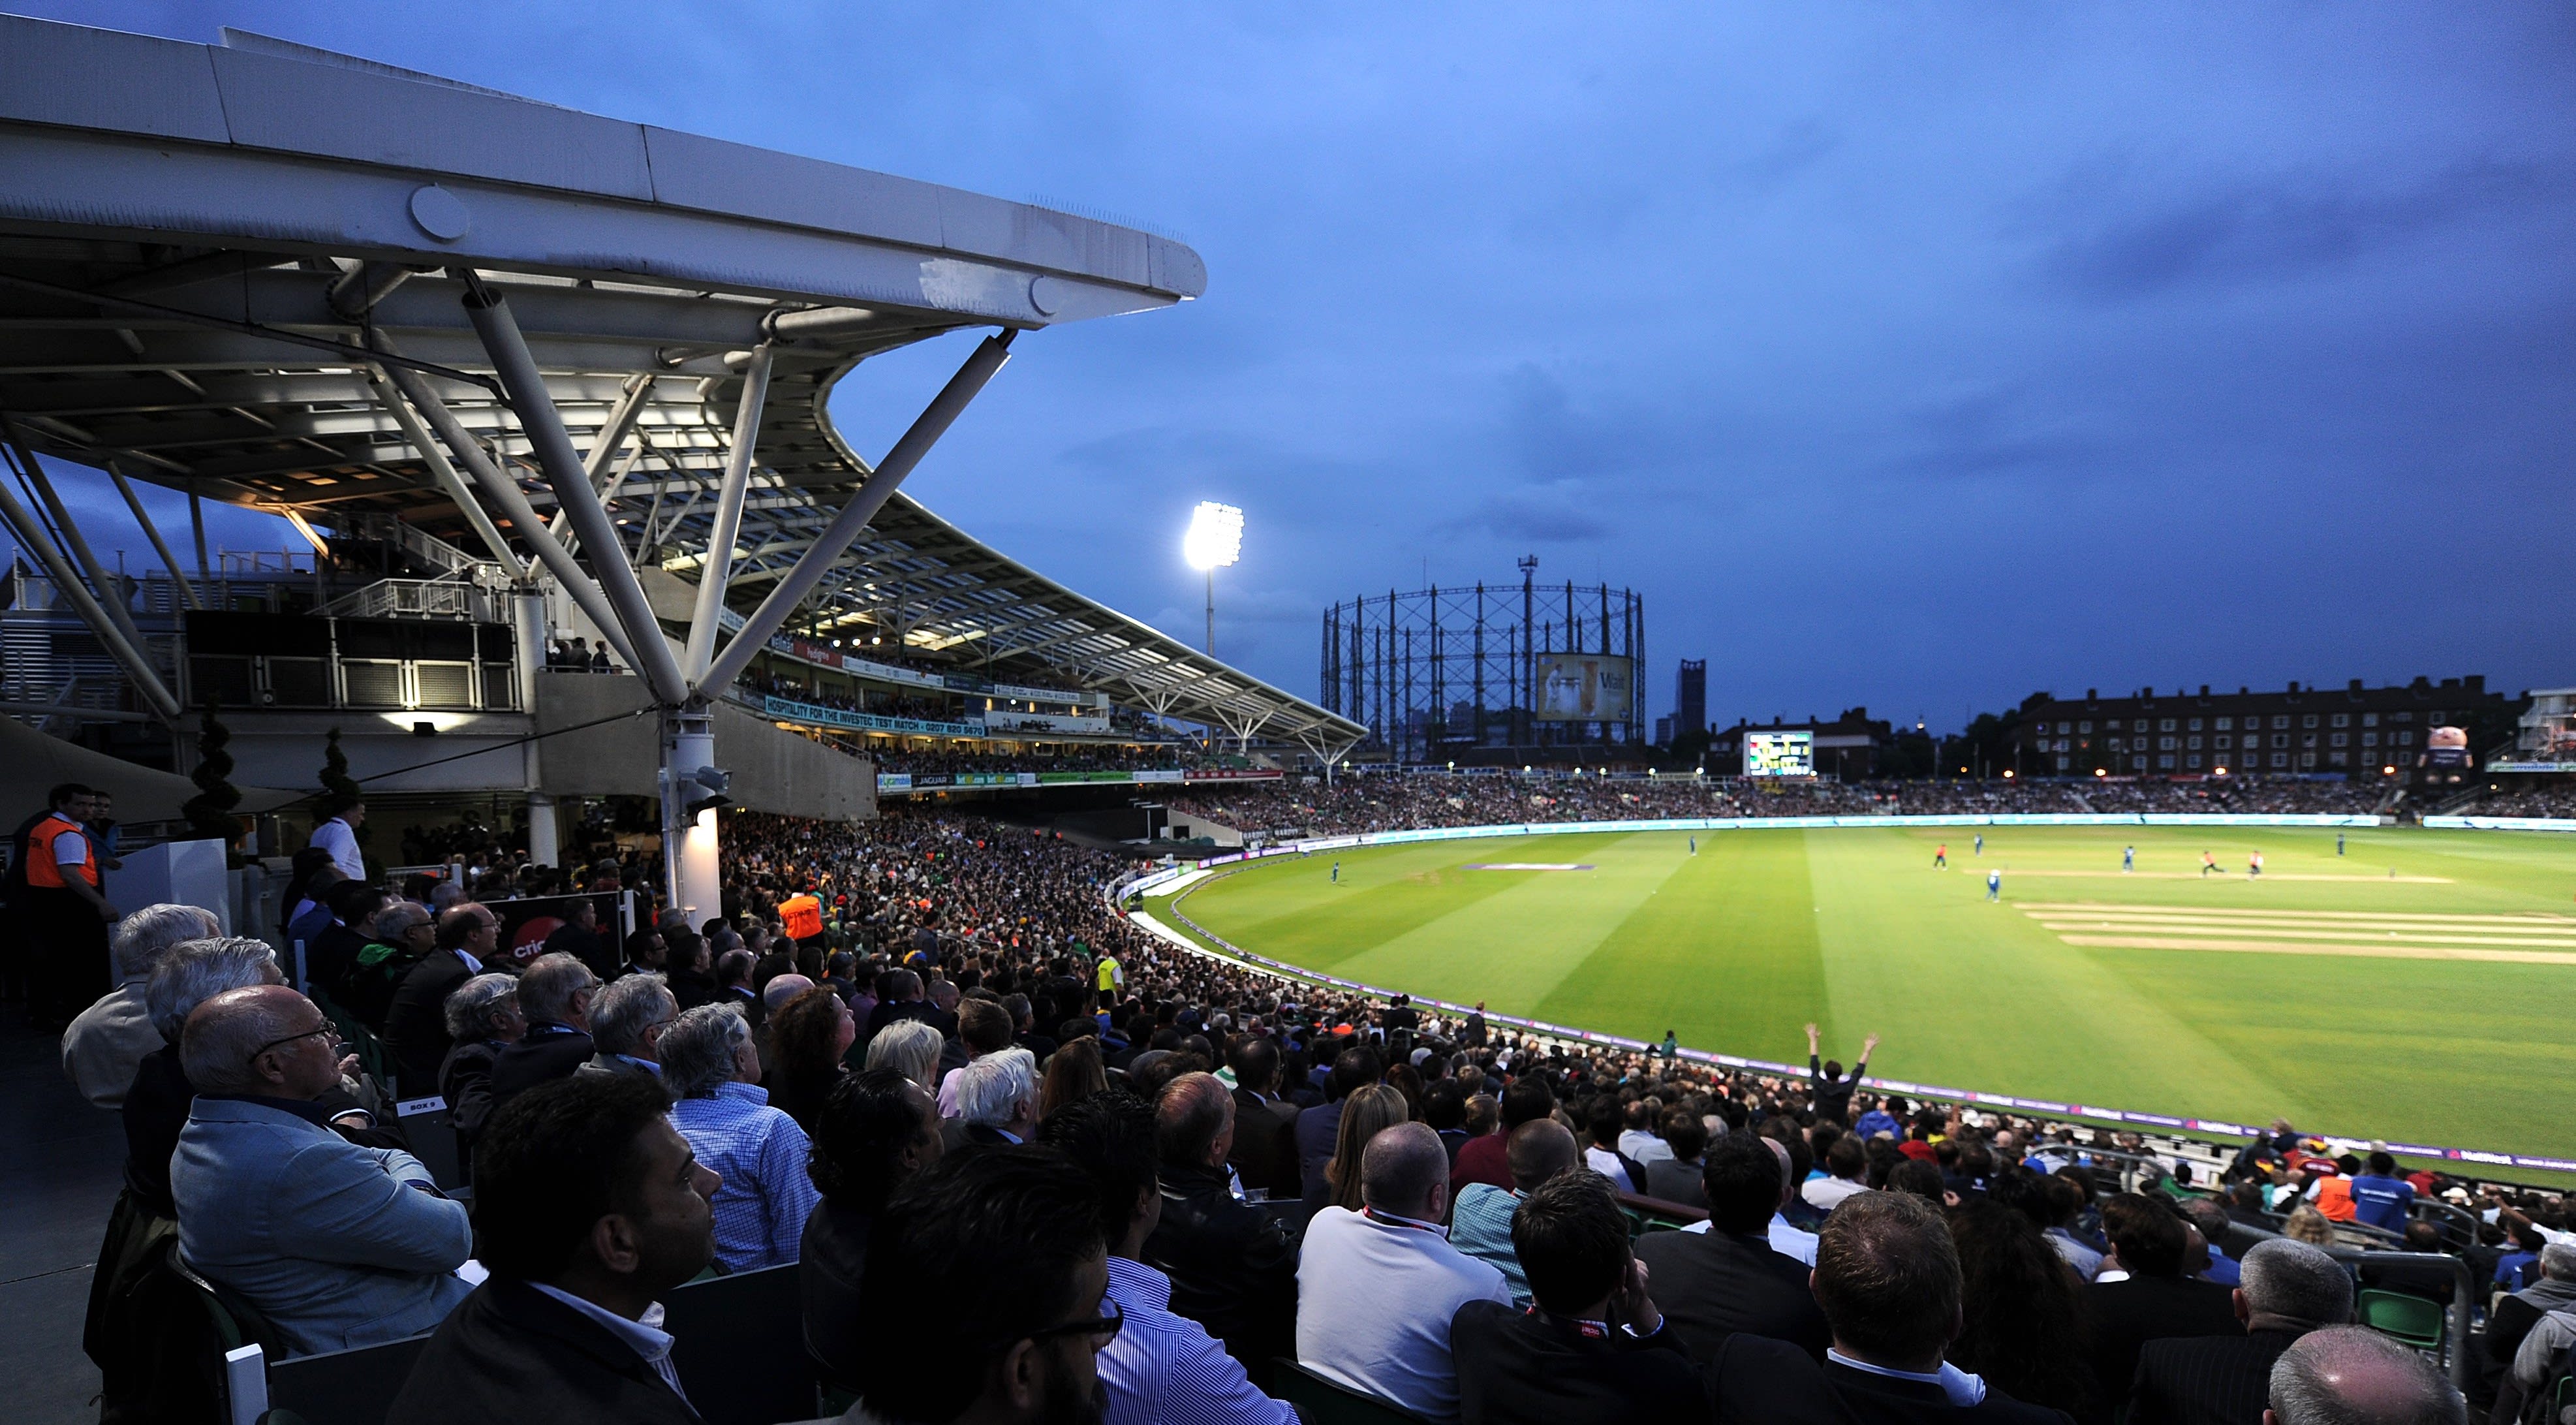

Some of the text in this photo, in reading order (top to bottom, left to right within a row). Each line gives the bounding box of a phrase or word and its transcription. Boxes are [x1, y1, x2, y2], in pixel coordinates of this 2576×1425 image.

[768, 699, 807, 718] HOSPITALITY
[809, 708, 823, 719] FOR
[825, 710, 838, 721] THE
[840, 713, 873, 727] INVESTEC
[875, 719, 892, 728] TEST
[894, 720, 919, 730] MATCH
[925, 723, 944, 732] 0207
[964, 726, 982, 735] 5670
